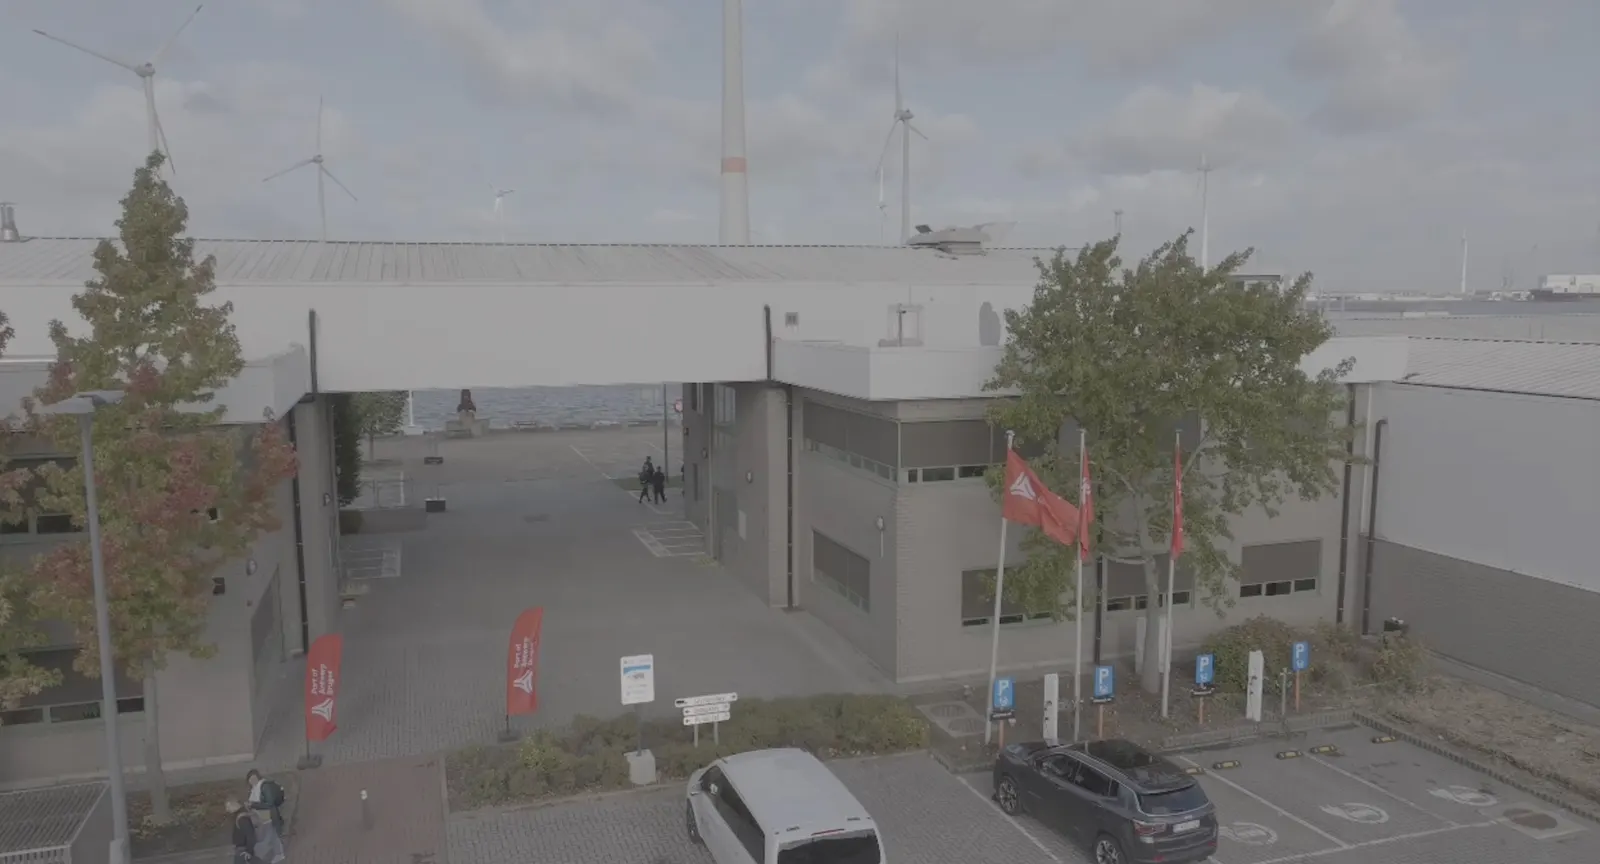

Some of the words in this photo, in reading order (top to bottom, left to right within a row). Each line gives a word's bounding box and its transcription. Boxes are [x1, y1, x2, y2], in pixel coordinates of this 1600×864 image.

[1295, 644, 1304, 659] P
[1200, 656, 1209, 673] P
[1099, 668, 1109, 685] P
[998, 680, 1009, 697] P
